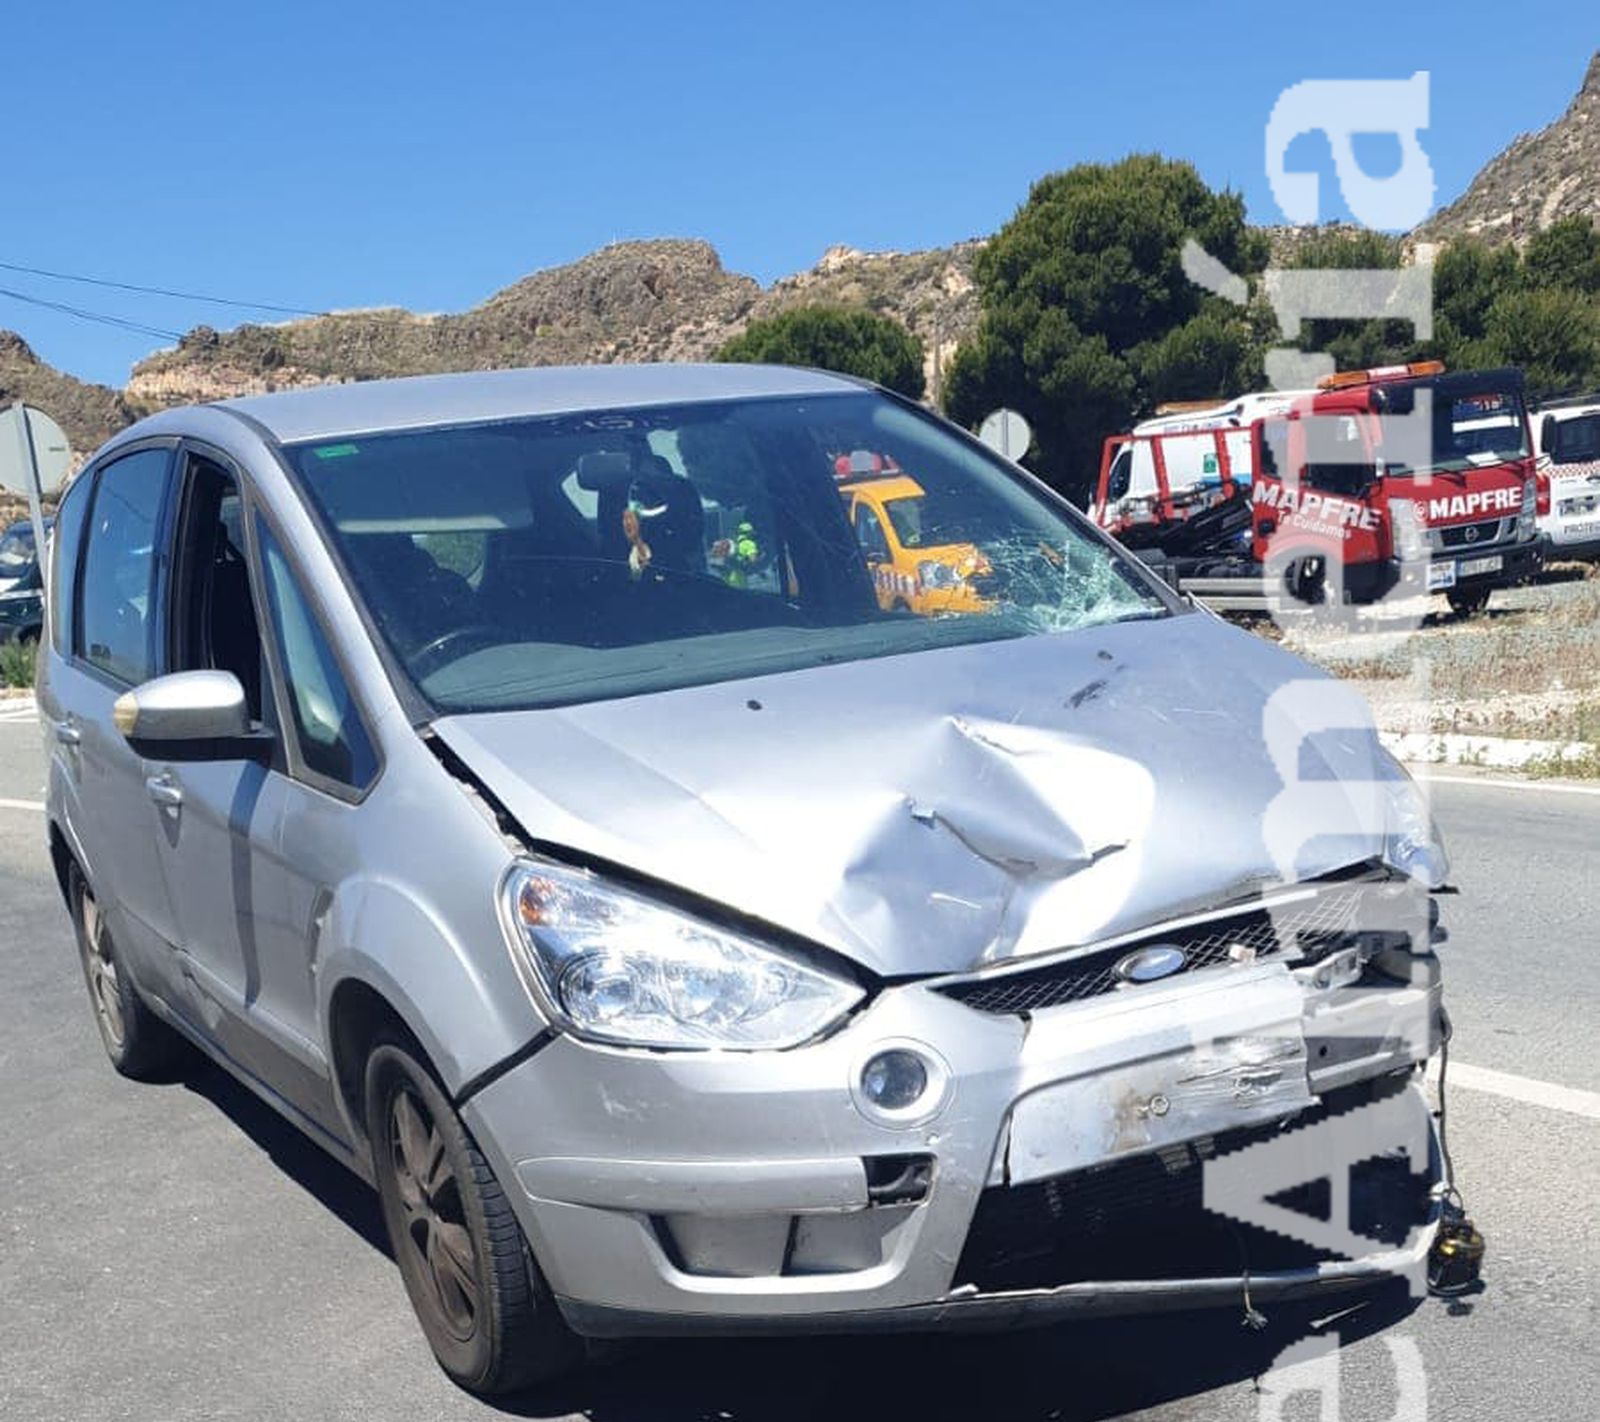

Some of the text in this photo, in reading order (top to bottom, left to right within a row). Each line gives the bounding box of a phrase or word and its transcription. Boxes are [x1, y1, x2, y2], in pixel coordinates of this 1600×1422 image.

[1252, 480, 1381, 530] MAPFRE
[1429, 487, 1522, 519] MAPFRE
[1293, 513, 1351, 540] Cuidamos
